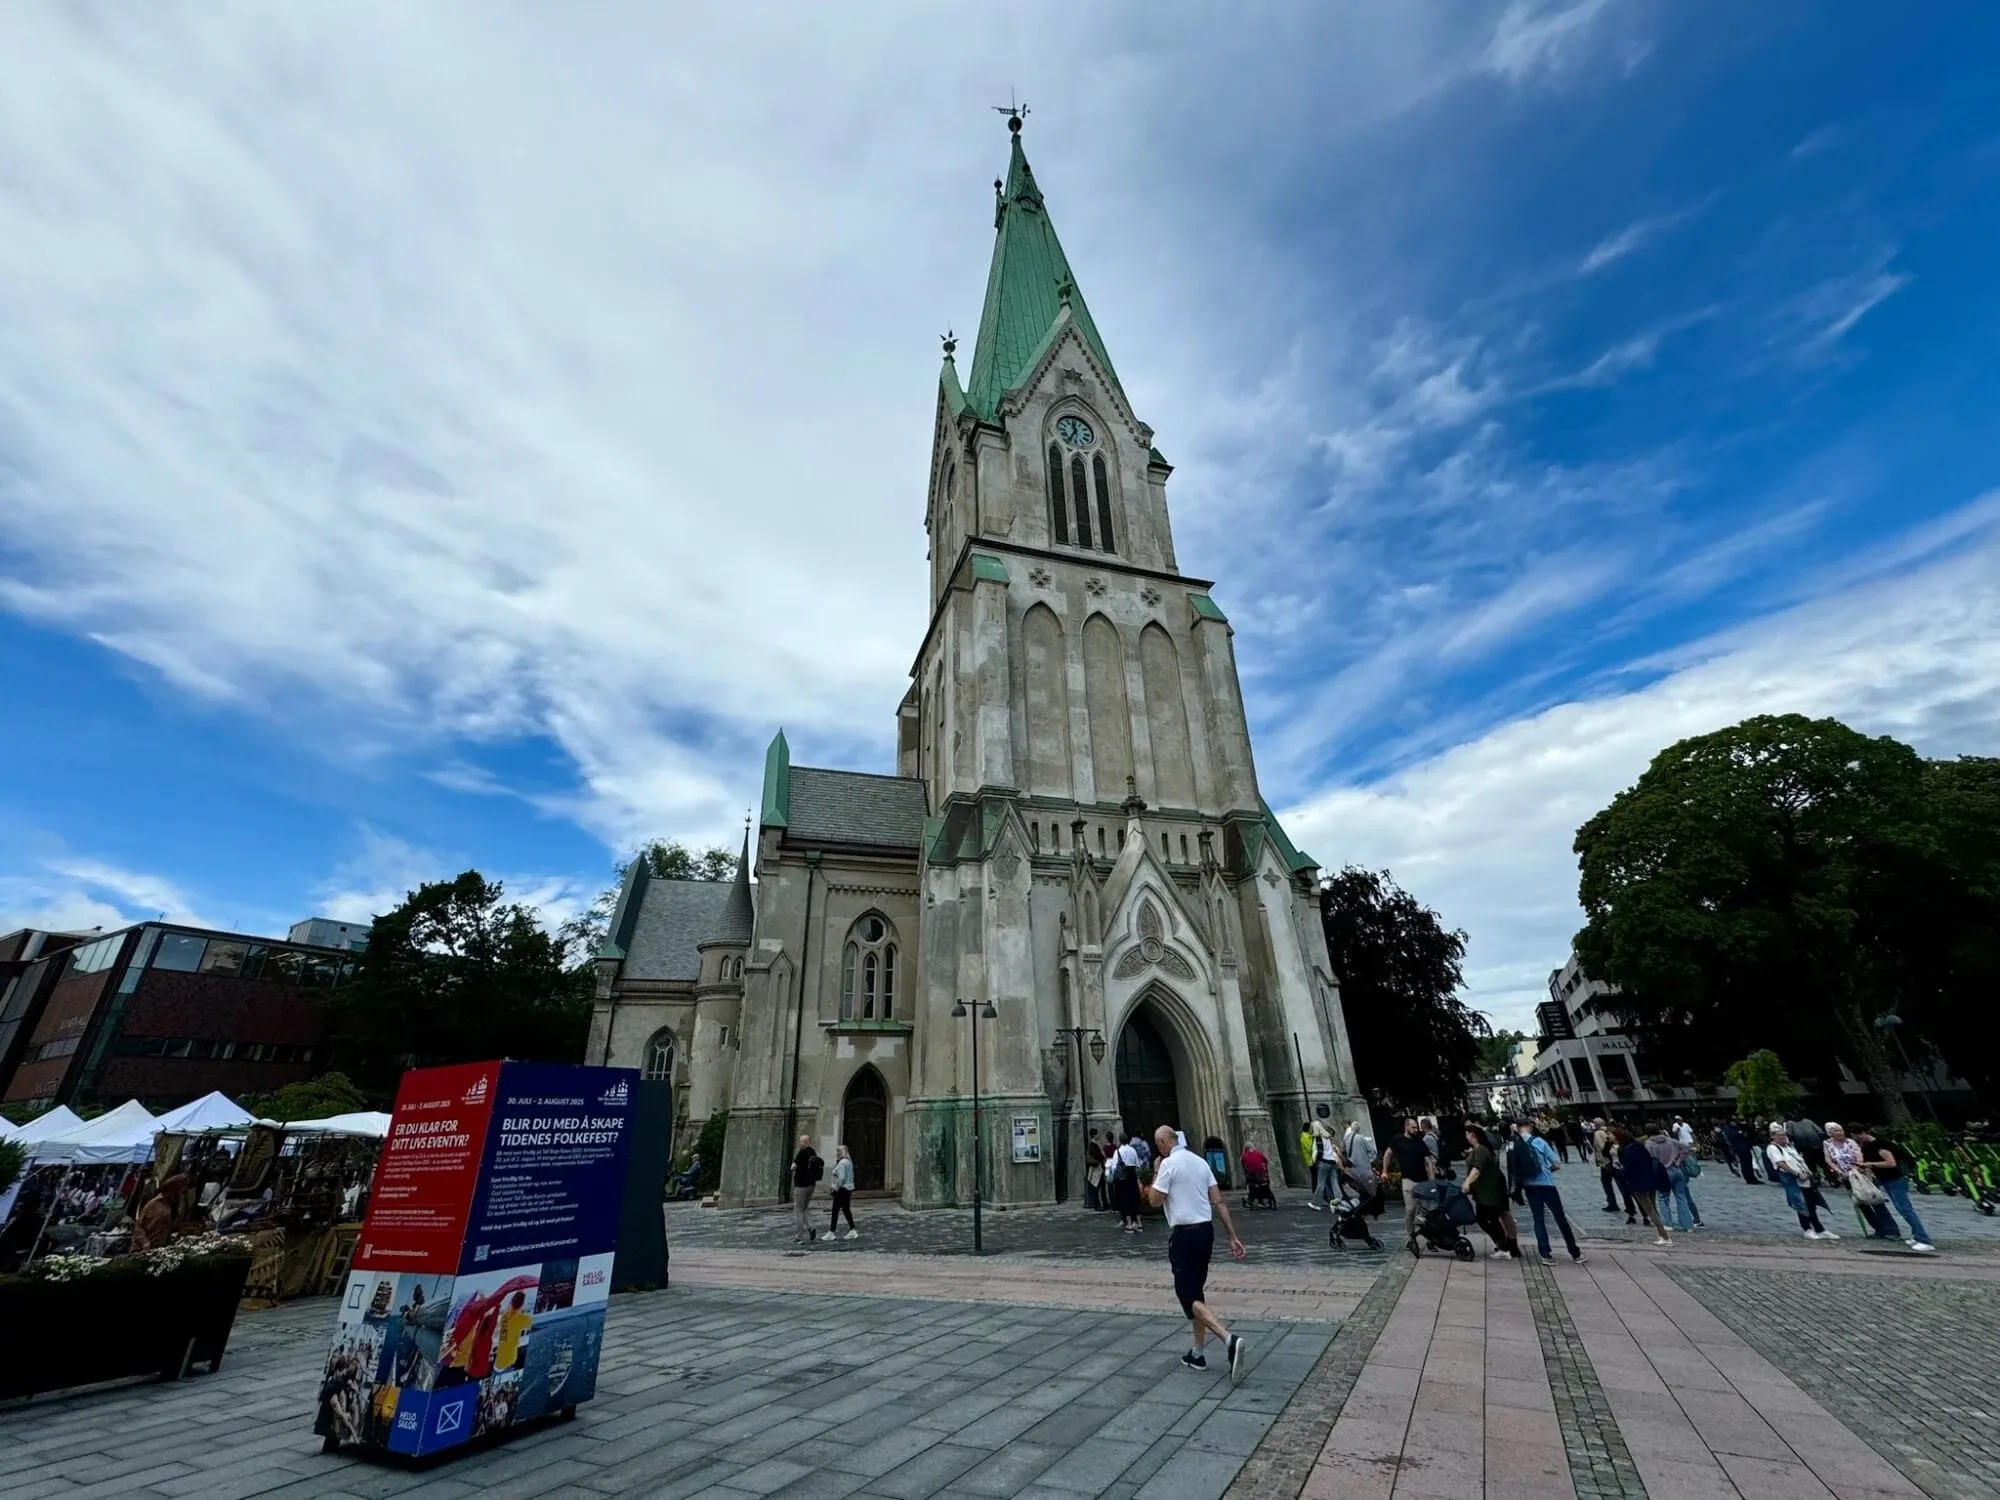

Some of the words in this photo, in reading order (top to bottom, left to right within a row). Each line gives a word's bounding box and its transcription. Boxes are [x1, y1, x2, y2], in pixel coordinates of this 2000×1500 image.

[518, 1097, 532, 1105] JULI
[544, 1097, 569, 1105] AUGUST
[569, 1098, 584, 1106] 2025
[395, 1123, 406, 1136] ER
[405, 1122, 419, 1135] DU
[418, 1121, 440, 1134] KLAR
[440, 1120, 458, 1133] FOR
[502, 1117, 531, 1130] BLIR
[532, 1118, 551, 1130] DU
[552, 1118, 580, 1130] MED
[580, 1115, 589, 1130] Å
[590, 1117, 625, 1129] SKAPE
[391, 1137, 410, 1151] DITT
[409, 1136, 428, 1150] LIVS
[427, 1135, 469, 1149] EVENTYR?
[500, 1133, 552, 1146] TIDENES
[553, 1131, 619, 1145] FOLKEFEST?
[583, 1270, 603, 1279] HELLO
[399, 1411, 417, 1421] HELLO
